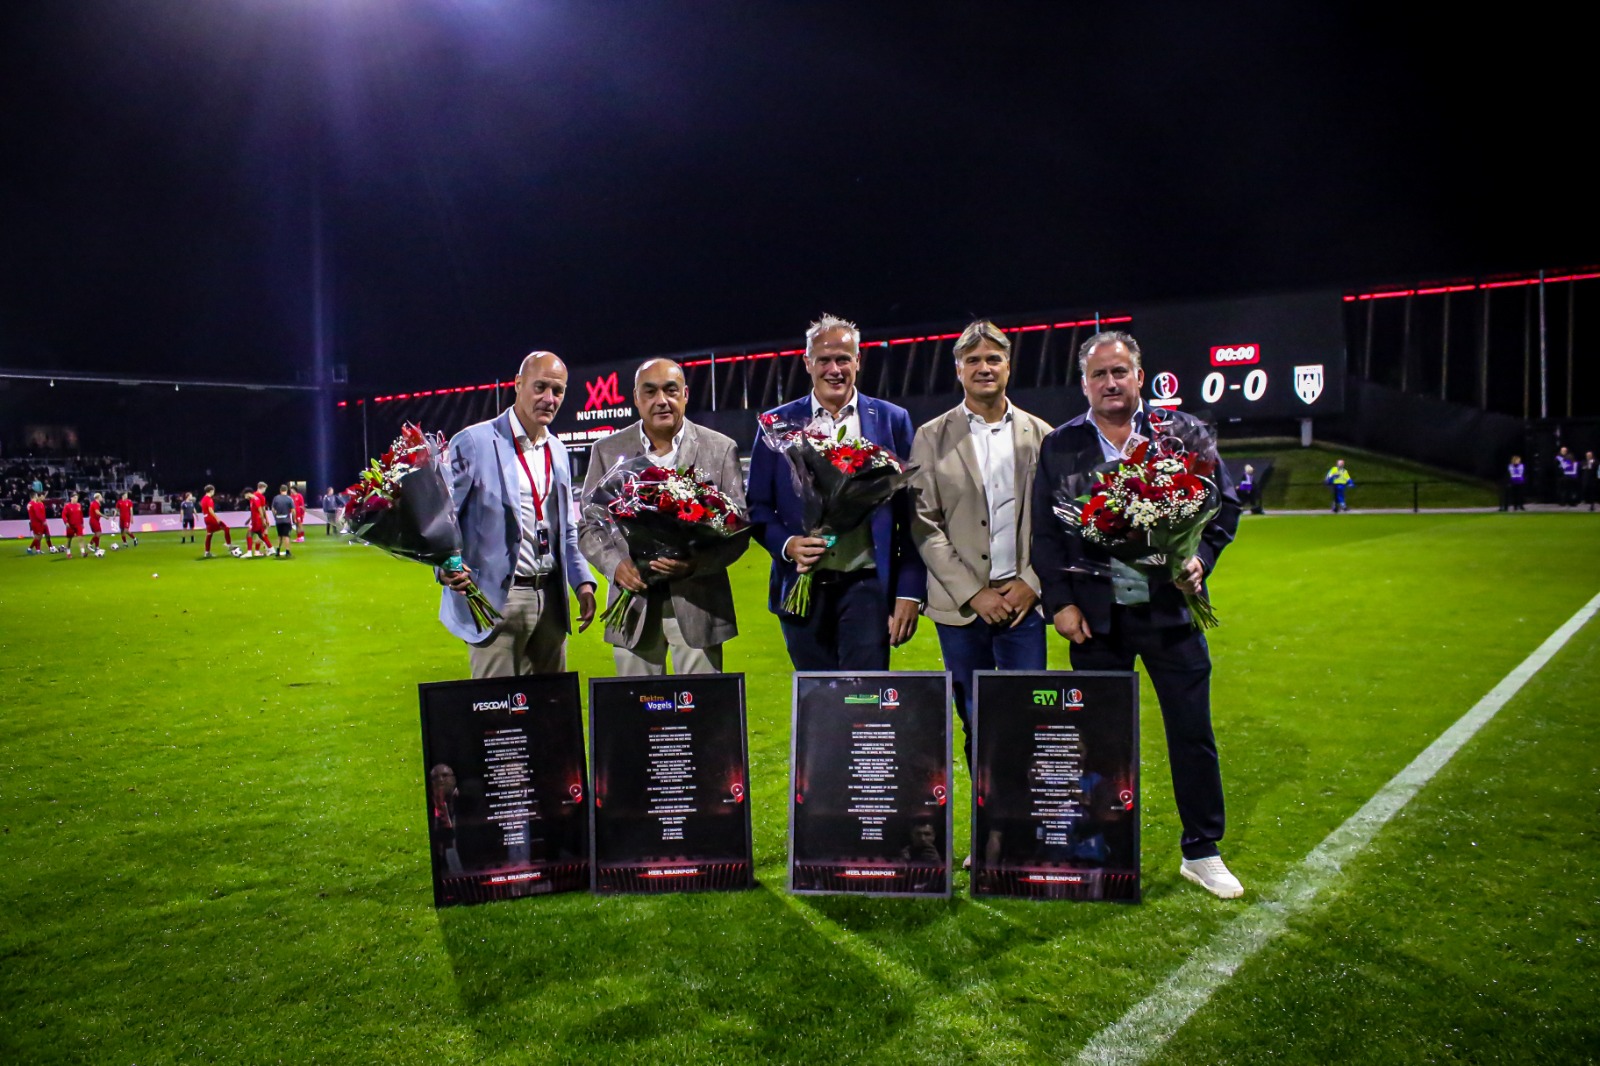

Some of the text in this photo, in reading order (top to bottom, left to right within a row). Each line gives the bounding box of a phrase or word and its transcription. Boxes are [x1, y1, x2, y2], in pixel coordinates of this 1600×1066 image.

[1215, 346, 1255, 362] 00:00
[584, 371, 626, 411] XXL
[576, 407, 632, 421] NUTRITION
[639, 694, 665, 703] Elektro
[1032, 689, 1058, 706] GW
[472, 700, 508, 712] VESCOM
[647, 701, 672, 711] Vogels
[507, 871, 541, 881] BRAINPORT
[663, 867, 698, 876] BRAINPORT
[861, 869, 896, 877] BRAINPORT
[1045, 874, 1081, 882] BRAINPORT
